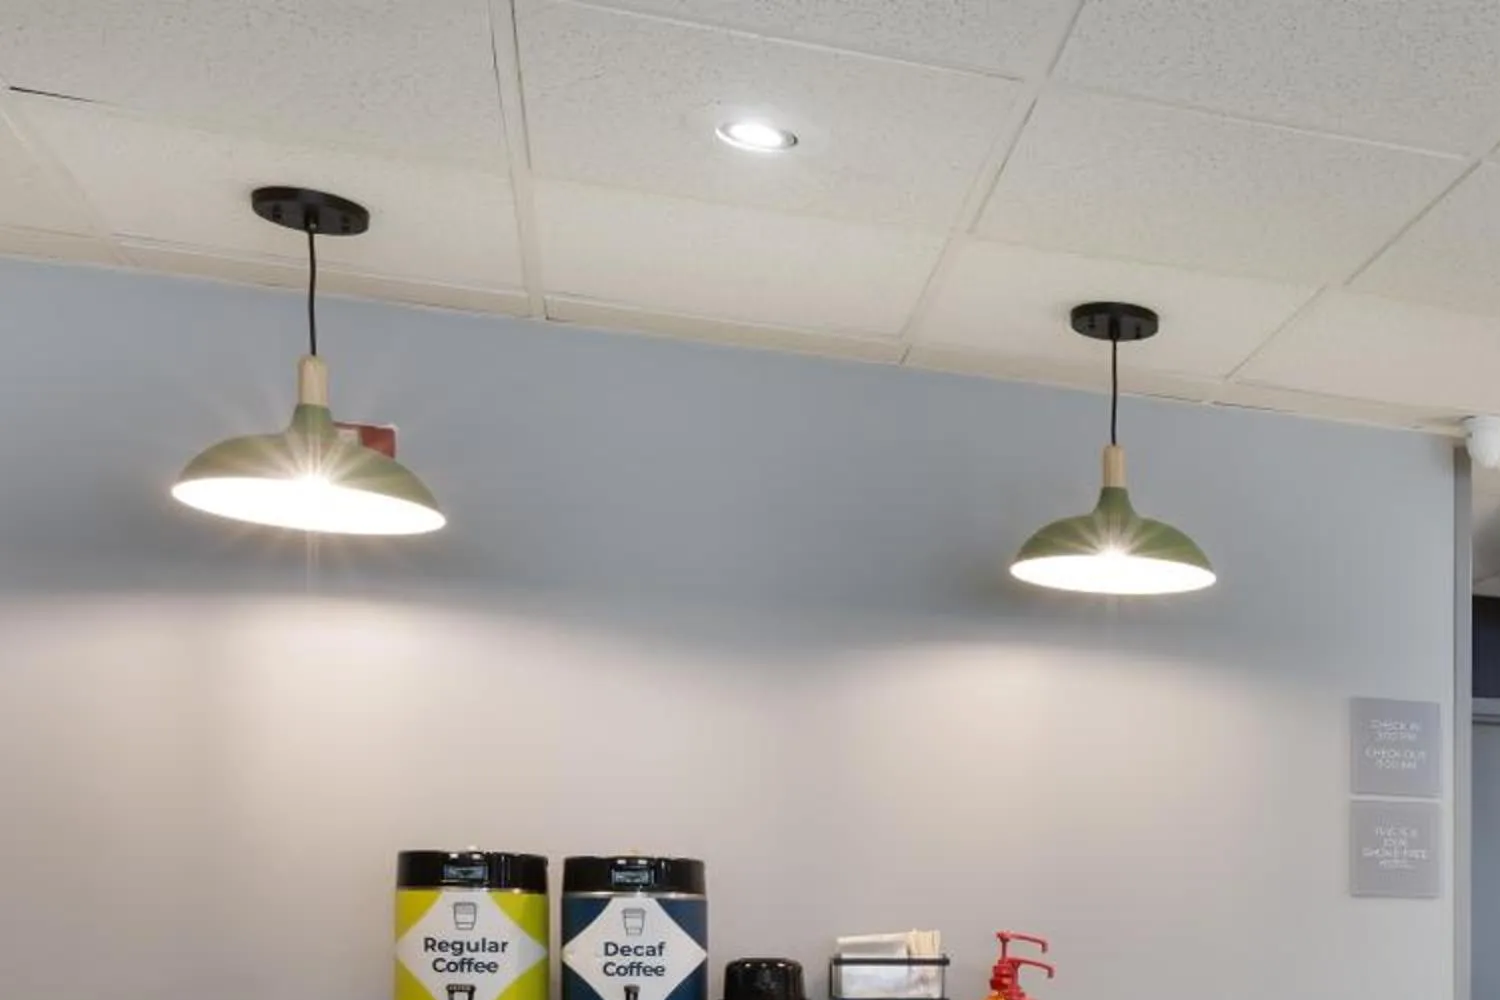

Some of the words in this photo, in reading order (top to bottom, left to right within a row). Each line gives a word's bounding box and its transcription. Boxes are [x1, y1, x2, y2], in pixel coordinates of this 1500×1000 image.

[423, 937, 509, 957] Regular
[604, 941, 665, 957] Decaf
[431, 957, 499, 974] Coffee
[602, 961, 666, 977] Coffee
